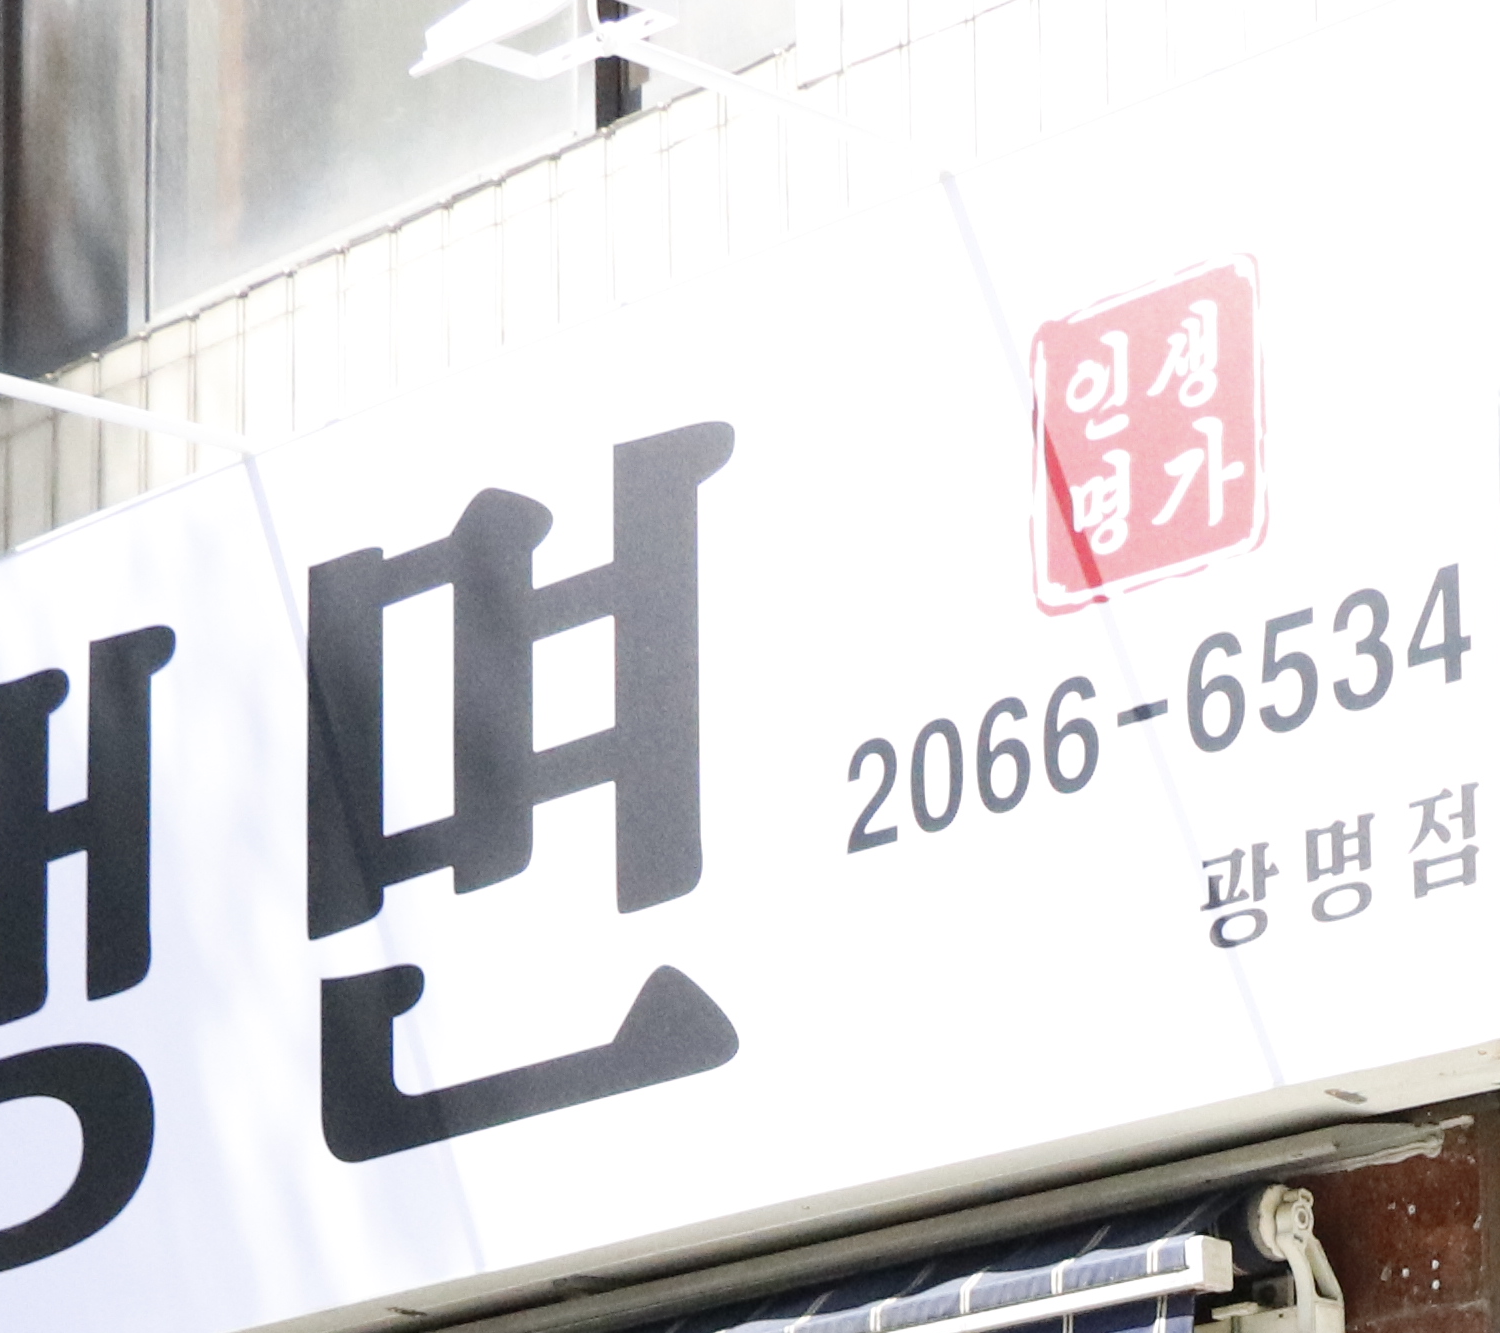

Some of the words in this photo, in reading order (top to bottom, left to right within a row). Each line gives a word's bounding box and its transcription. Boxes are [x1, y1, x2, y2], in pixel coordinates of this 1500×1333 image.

[1065, 298, 1219, 441] 인생
[1068, 415, 1246, 556] 명가
[844, 562, 1473, 855] 2066-6534
[1199, 781, 1480, 950] 광명점
